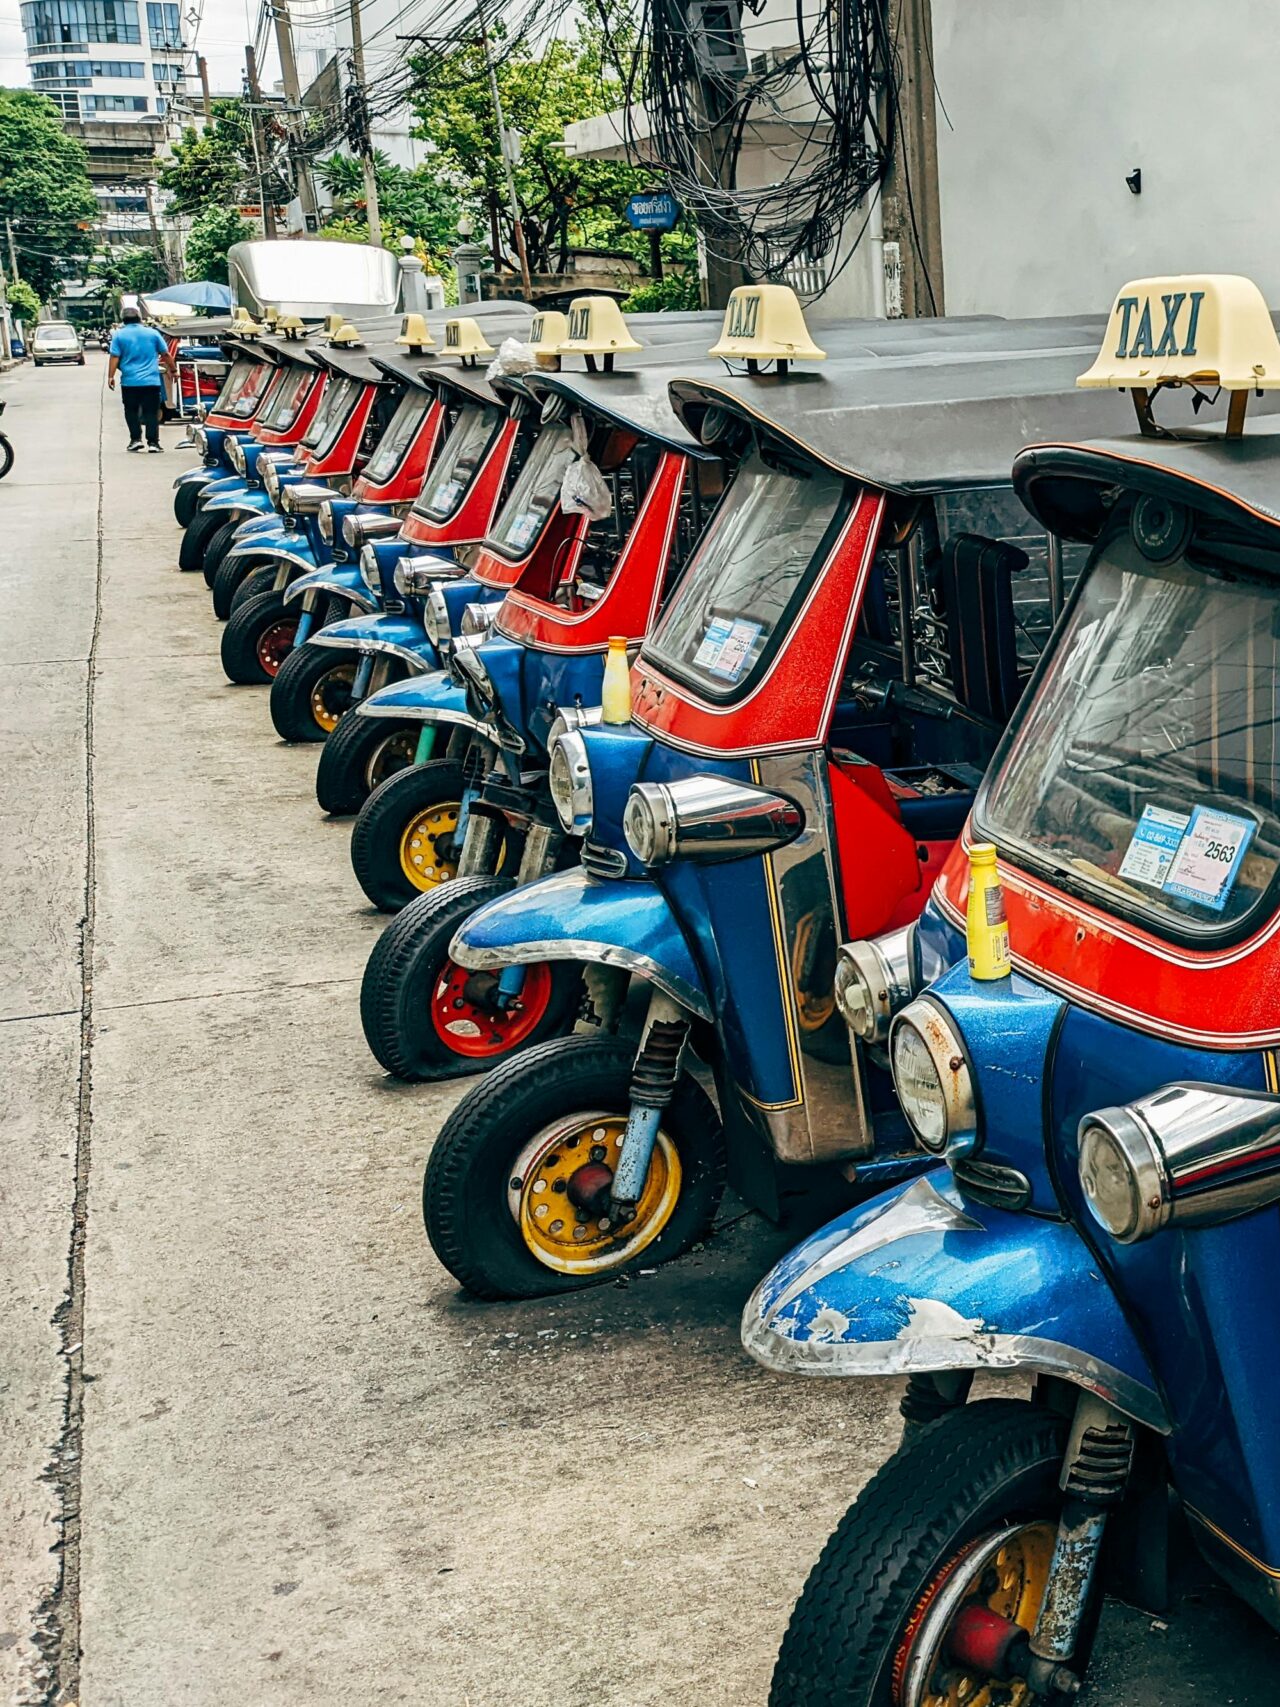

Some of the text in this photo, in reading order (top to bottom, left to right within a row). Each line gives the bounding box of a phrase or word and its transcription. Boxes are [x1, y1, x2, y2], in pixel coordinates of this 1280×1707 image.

[568, 308, 590, 340] TAXI
[727, 296, 760, 338] TAXI
[1115, 291, 1205, 359] TAXI
[1204, 841, 1236, 864] 2563
